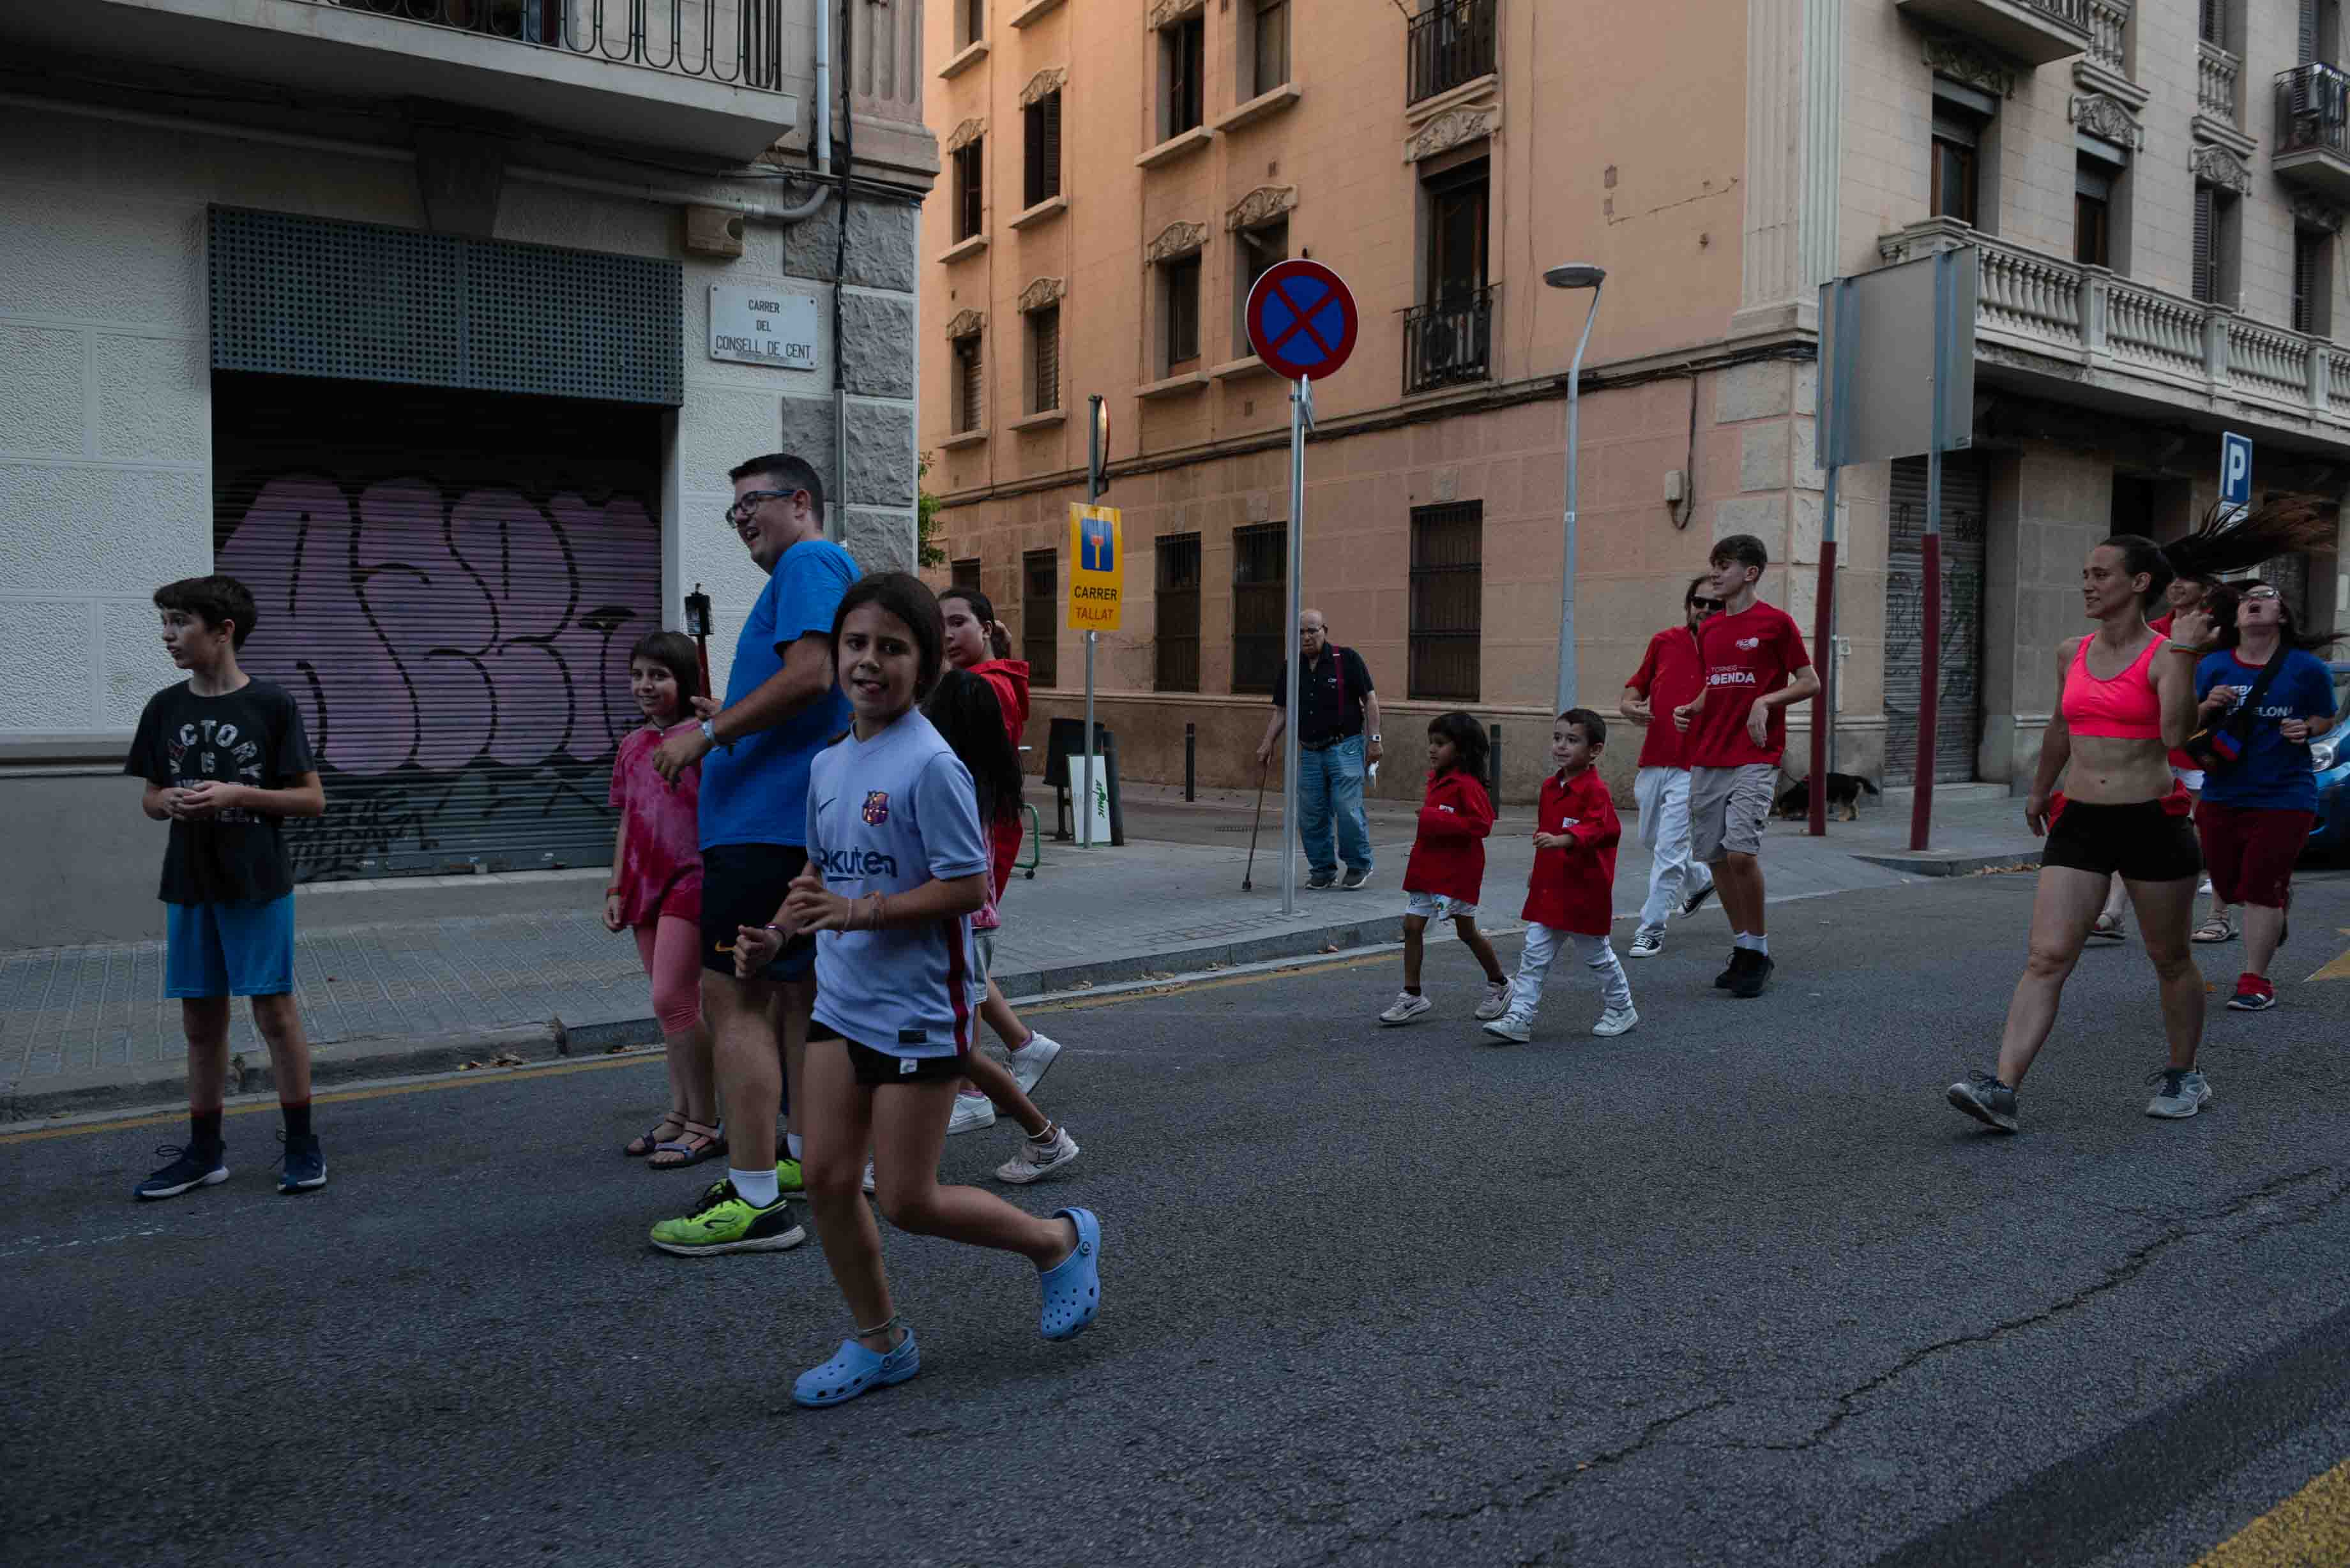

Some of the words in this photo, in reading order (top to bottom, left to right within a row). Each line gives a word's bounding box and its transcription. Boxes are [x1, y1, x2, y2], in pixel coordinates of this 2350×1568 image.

[748, 299, 780, 313] CARRER
[756, 320, 771, 332] DEL
[716, 335, 762, 354] CONSELL
[768, 340, 780, 356] DE
[786, 343, 811, 359] CENT
[2227, 442, 2246, 497] P
[1074, 585, 1118, 601] CARRER
[1075, 607, 1114, 621] TALLAT
[819, 847, 898, 878] akuten
